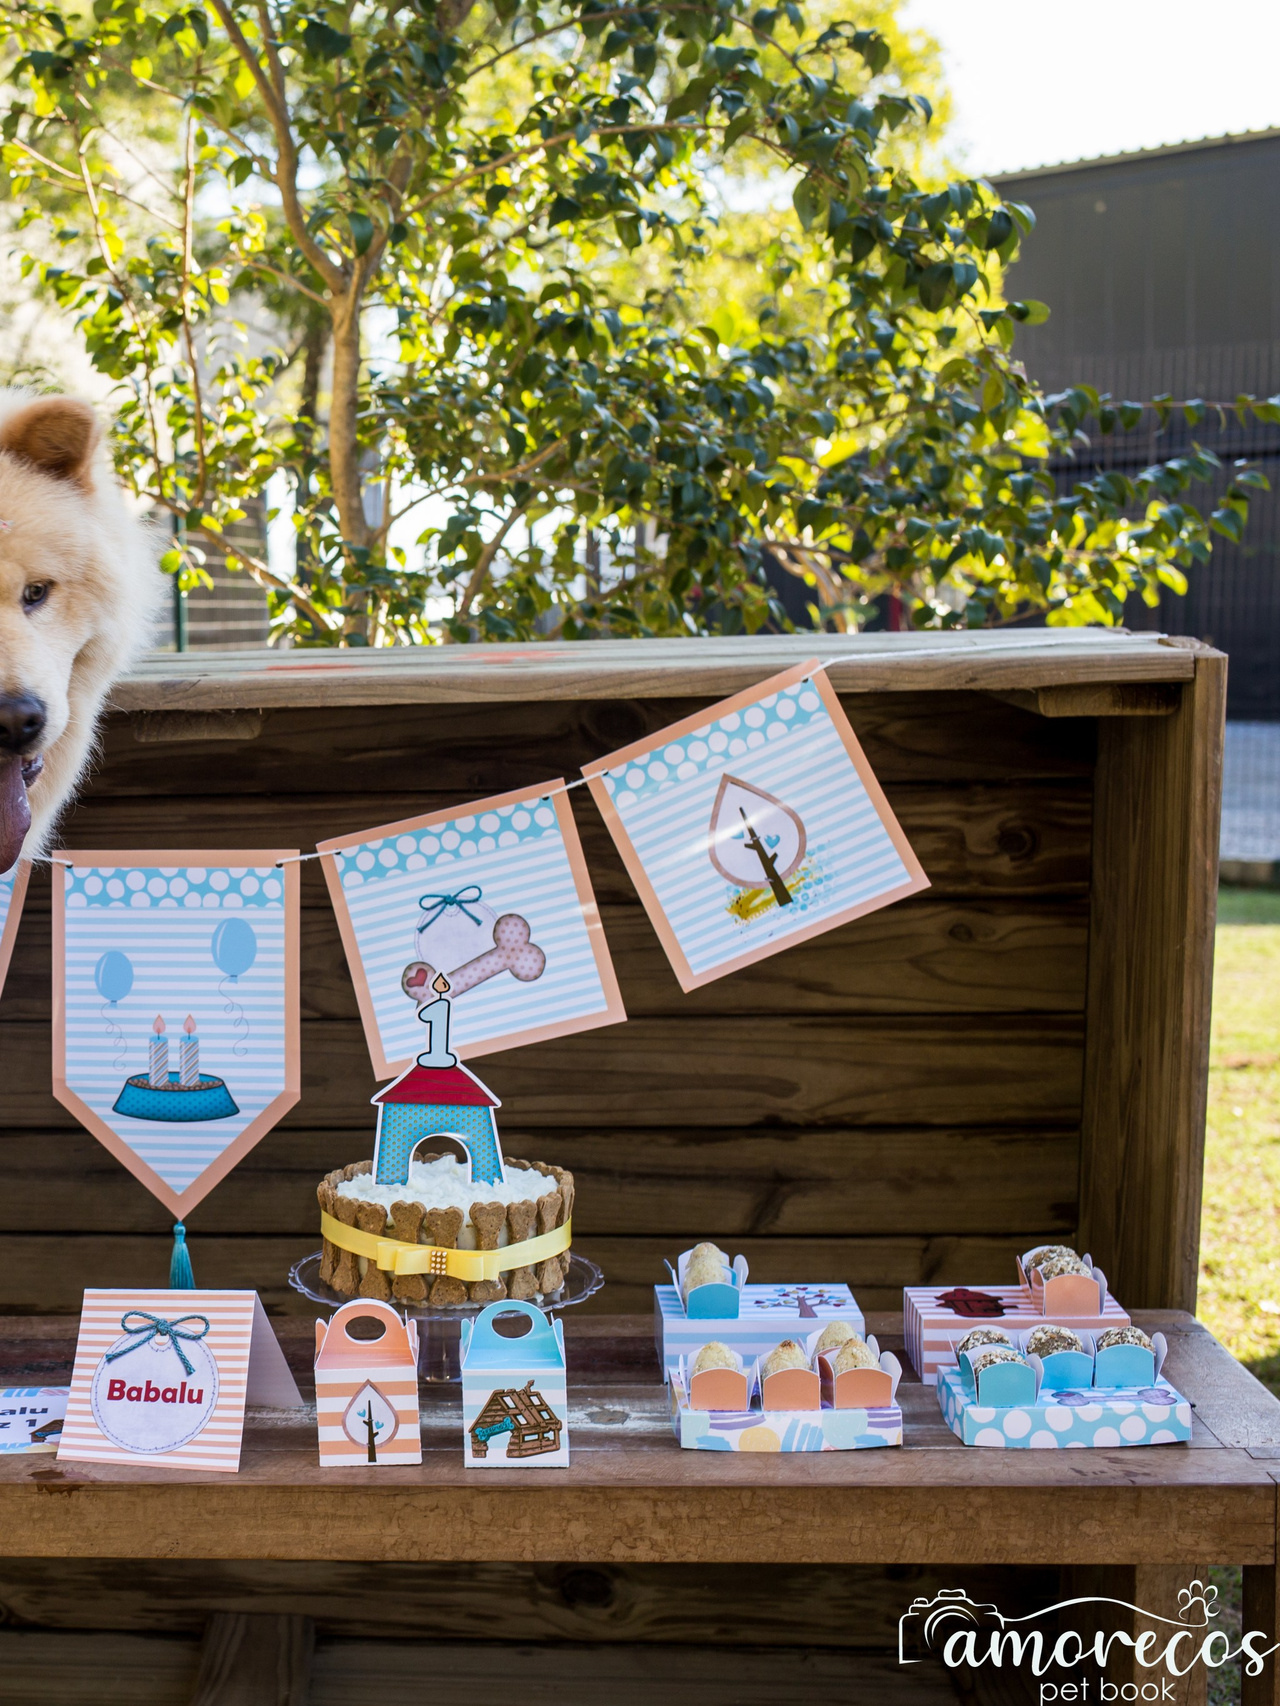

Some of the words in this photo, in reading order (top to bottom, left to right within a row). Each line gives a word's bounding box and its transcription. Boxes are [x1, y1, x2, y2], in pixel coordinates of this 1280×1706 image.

[416, 998, 458, 1069] 1
[106, 1378, 204, 1405] Babalu
[25, 1418, 38, 1428] 1
